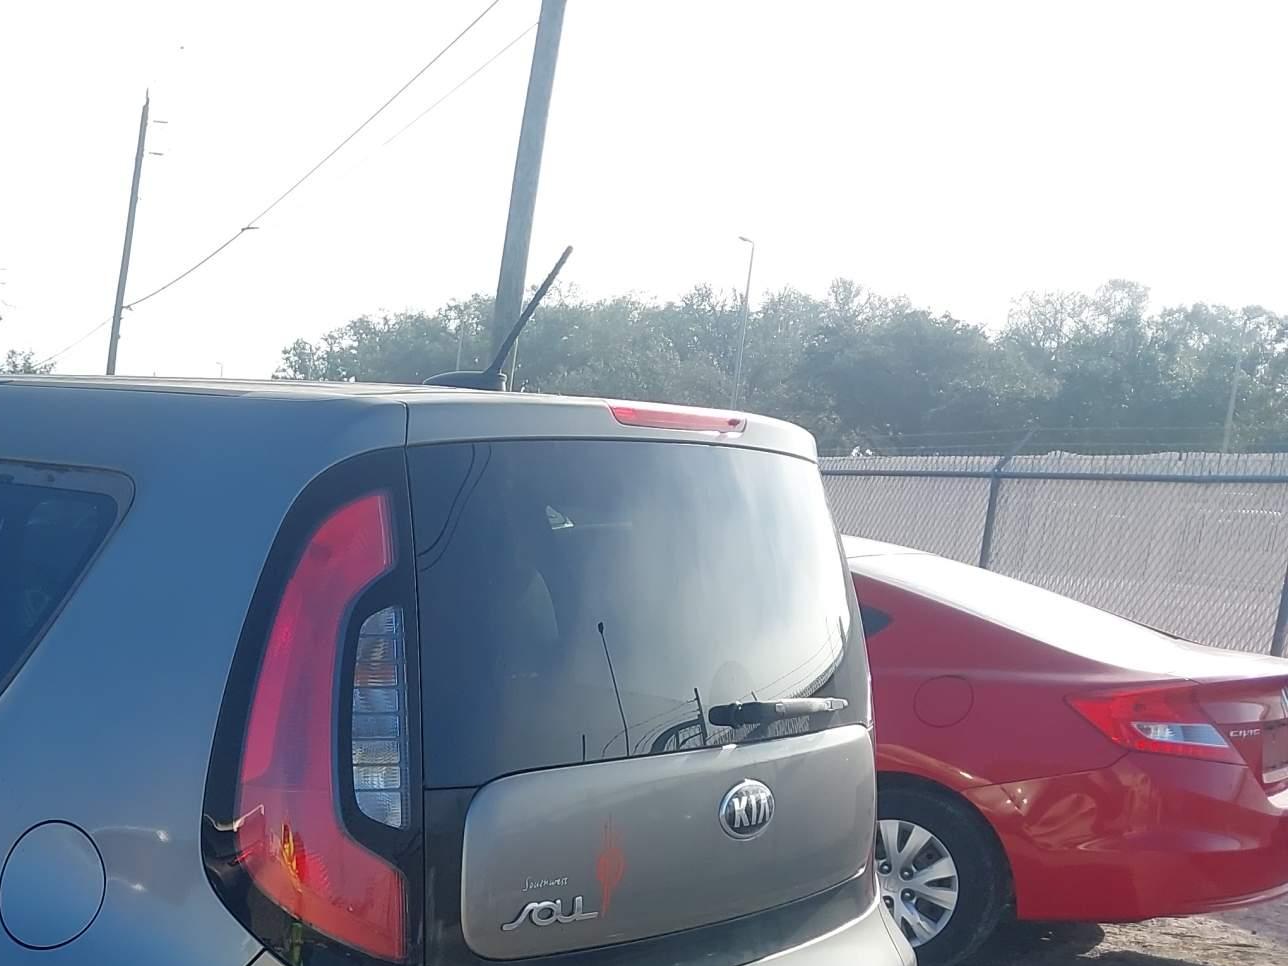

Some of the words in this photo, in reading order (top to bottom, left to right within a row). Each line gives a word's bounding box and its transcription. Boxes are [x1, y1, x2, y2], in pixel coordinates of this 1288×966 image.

[1229, 728, 1261, 737] CIVIC
[732, 792, 770, 828] KIA
[502, 896, 598, 930] SOUL
